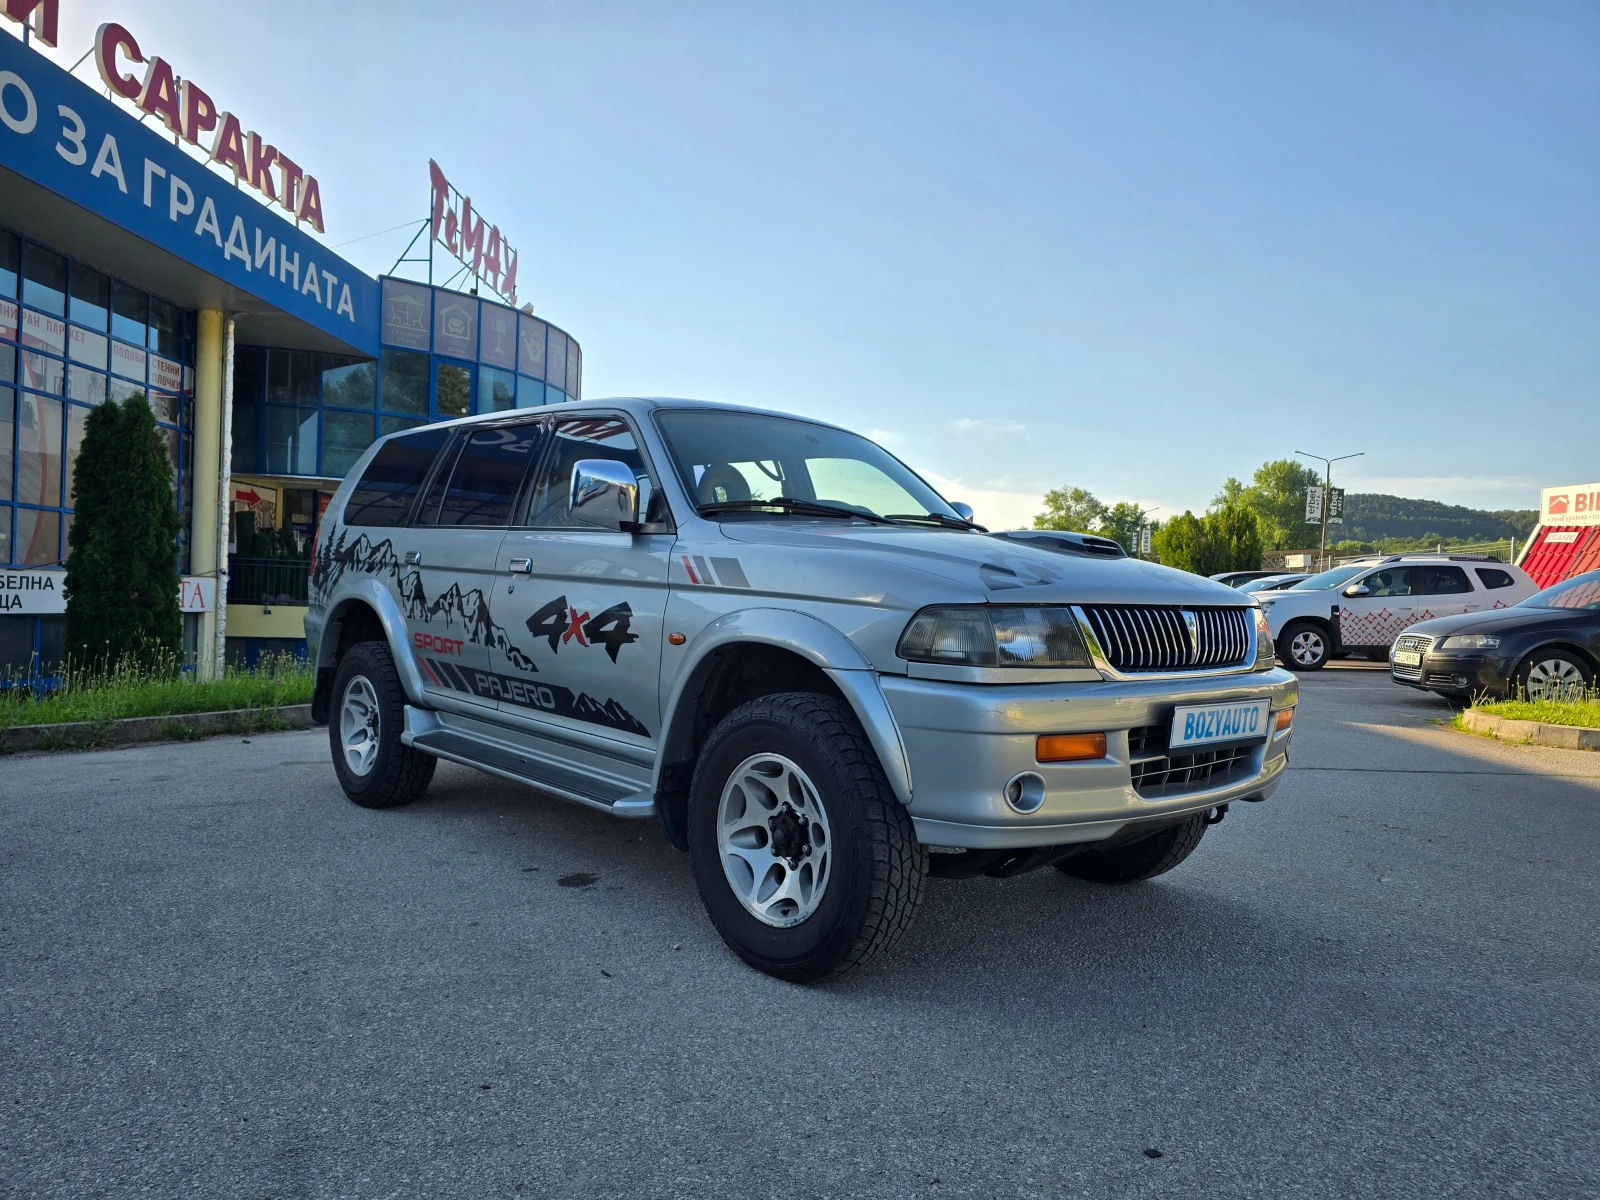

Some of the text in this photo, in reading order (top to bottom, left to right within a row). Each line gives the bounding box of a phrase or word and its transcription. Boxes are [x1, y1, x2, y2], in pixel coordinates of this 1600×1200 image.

[95, 22, 325, 234] САРАКТА
[55, 104, 128, 194] ЗА
[143, 157, 355, 322] ГРАДИНАТА
[46, 320, 86, 344] ПАРКЕТ
[396, 337, 417, 345] СТОКИ
[113, 344, 145, 365] ПОДОВИ
[152, 358, 180, 377] СТЕННИ
[152, 373, 181, 391] ПЛОЧКИ
[1308, 489, 1317, 514] efbet
[1330, 490, 1339, 516] efbet
[414, 632, 464, 657] SPORT
[475, 673, 555, 709] PAJERO
[1184, 706, 1260, 740] BOZYAUTO
